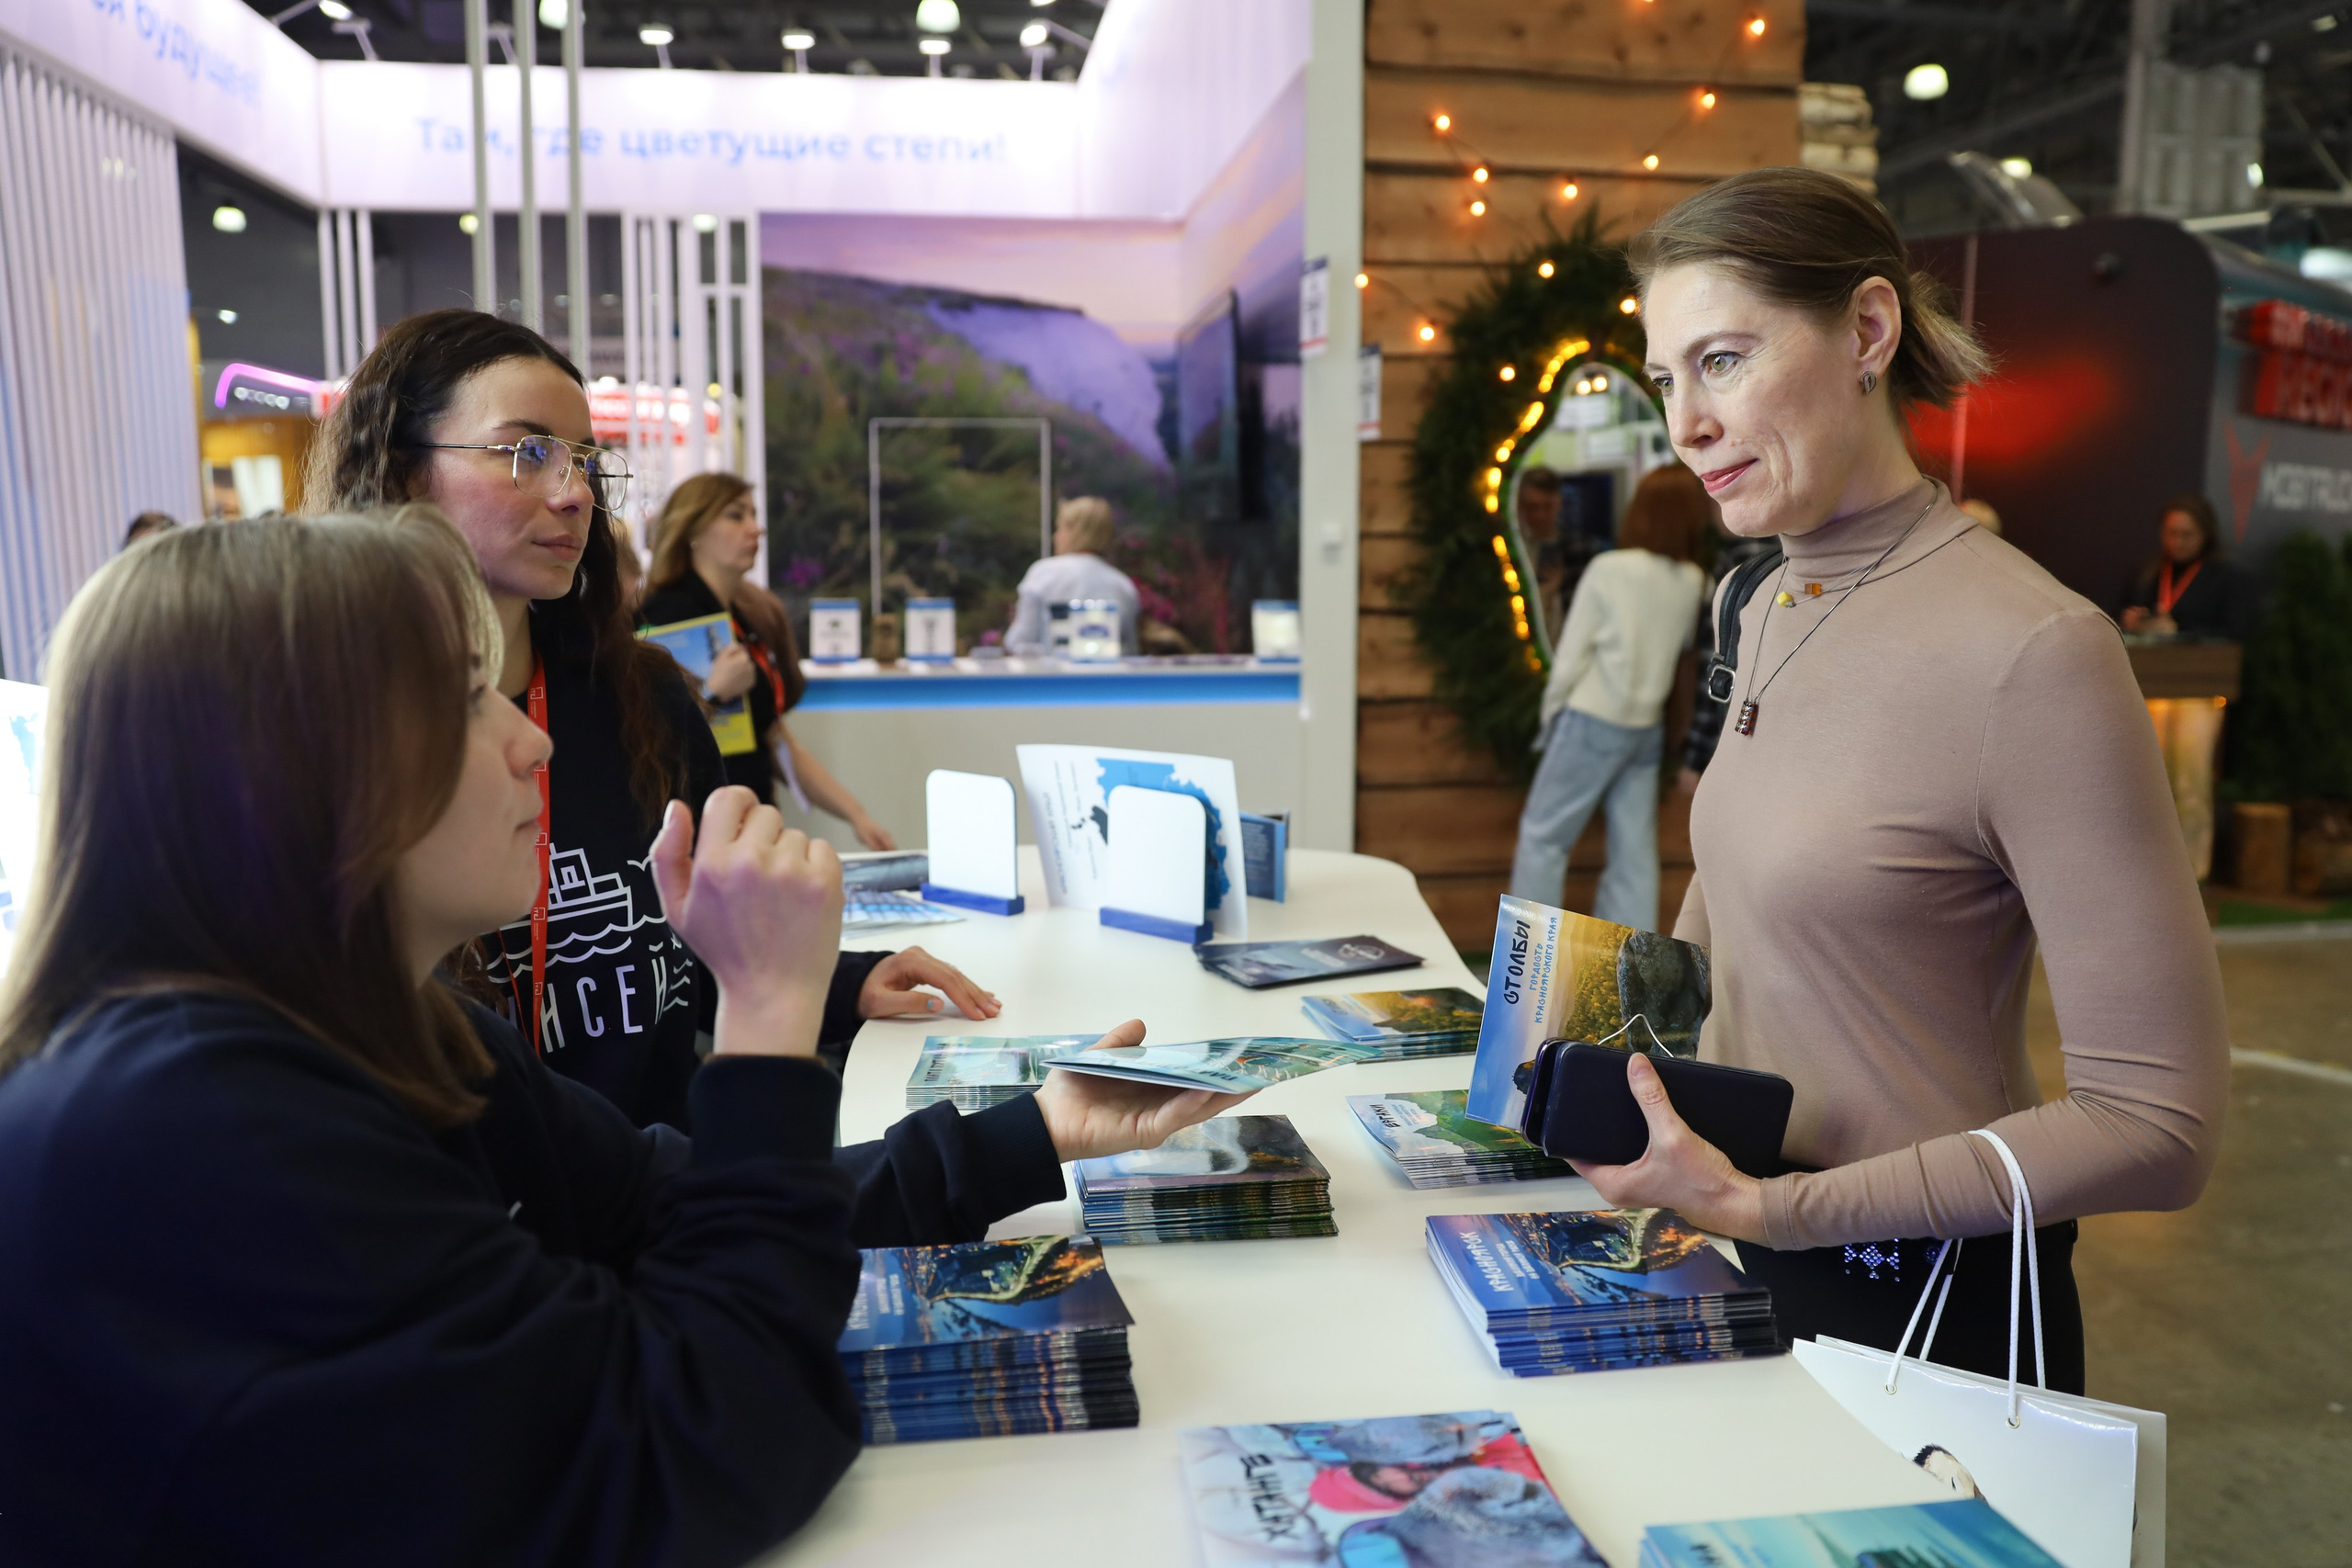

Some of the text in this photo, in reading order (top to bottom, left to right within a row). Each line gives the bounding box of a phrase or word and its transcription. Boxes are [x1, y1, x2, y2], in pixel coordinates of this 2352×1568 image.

[619, 128, 852, 167] цветущие
[863, 130, 1007, 163] степи!
[1503, 919, 1531, 1005] СТОЛБЫ
[1529, 942, 1544, 991] ГОРДОСТЬ
[1534, 917, 1558, 1024] КРАСНОЯРСКОГО КРАЯ
[1369, 1104, 1401, 1128] ЕРГАКИ
[1459, 1232, 1515, 1292] КРАСНОЯРСК
